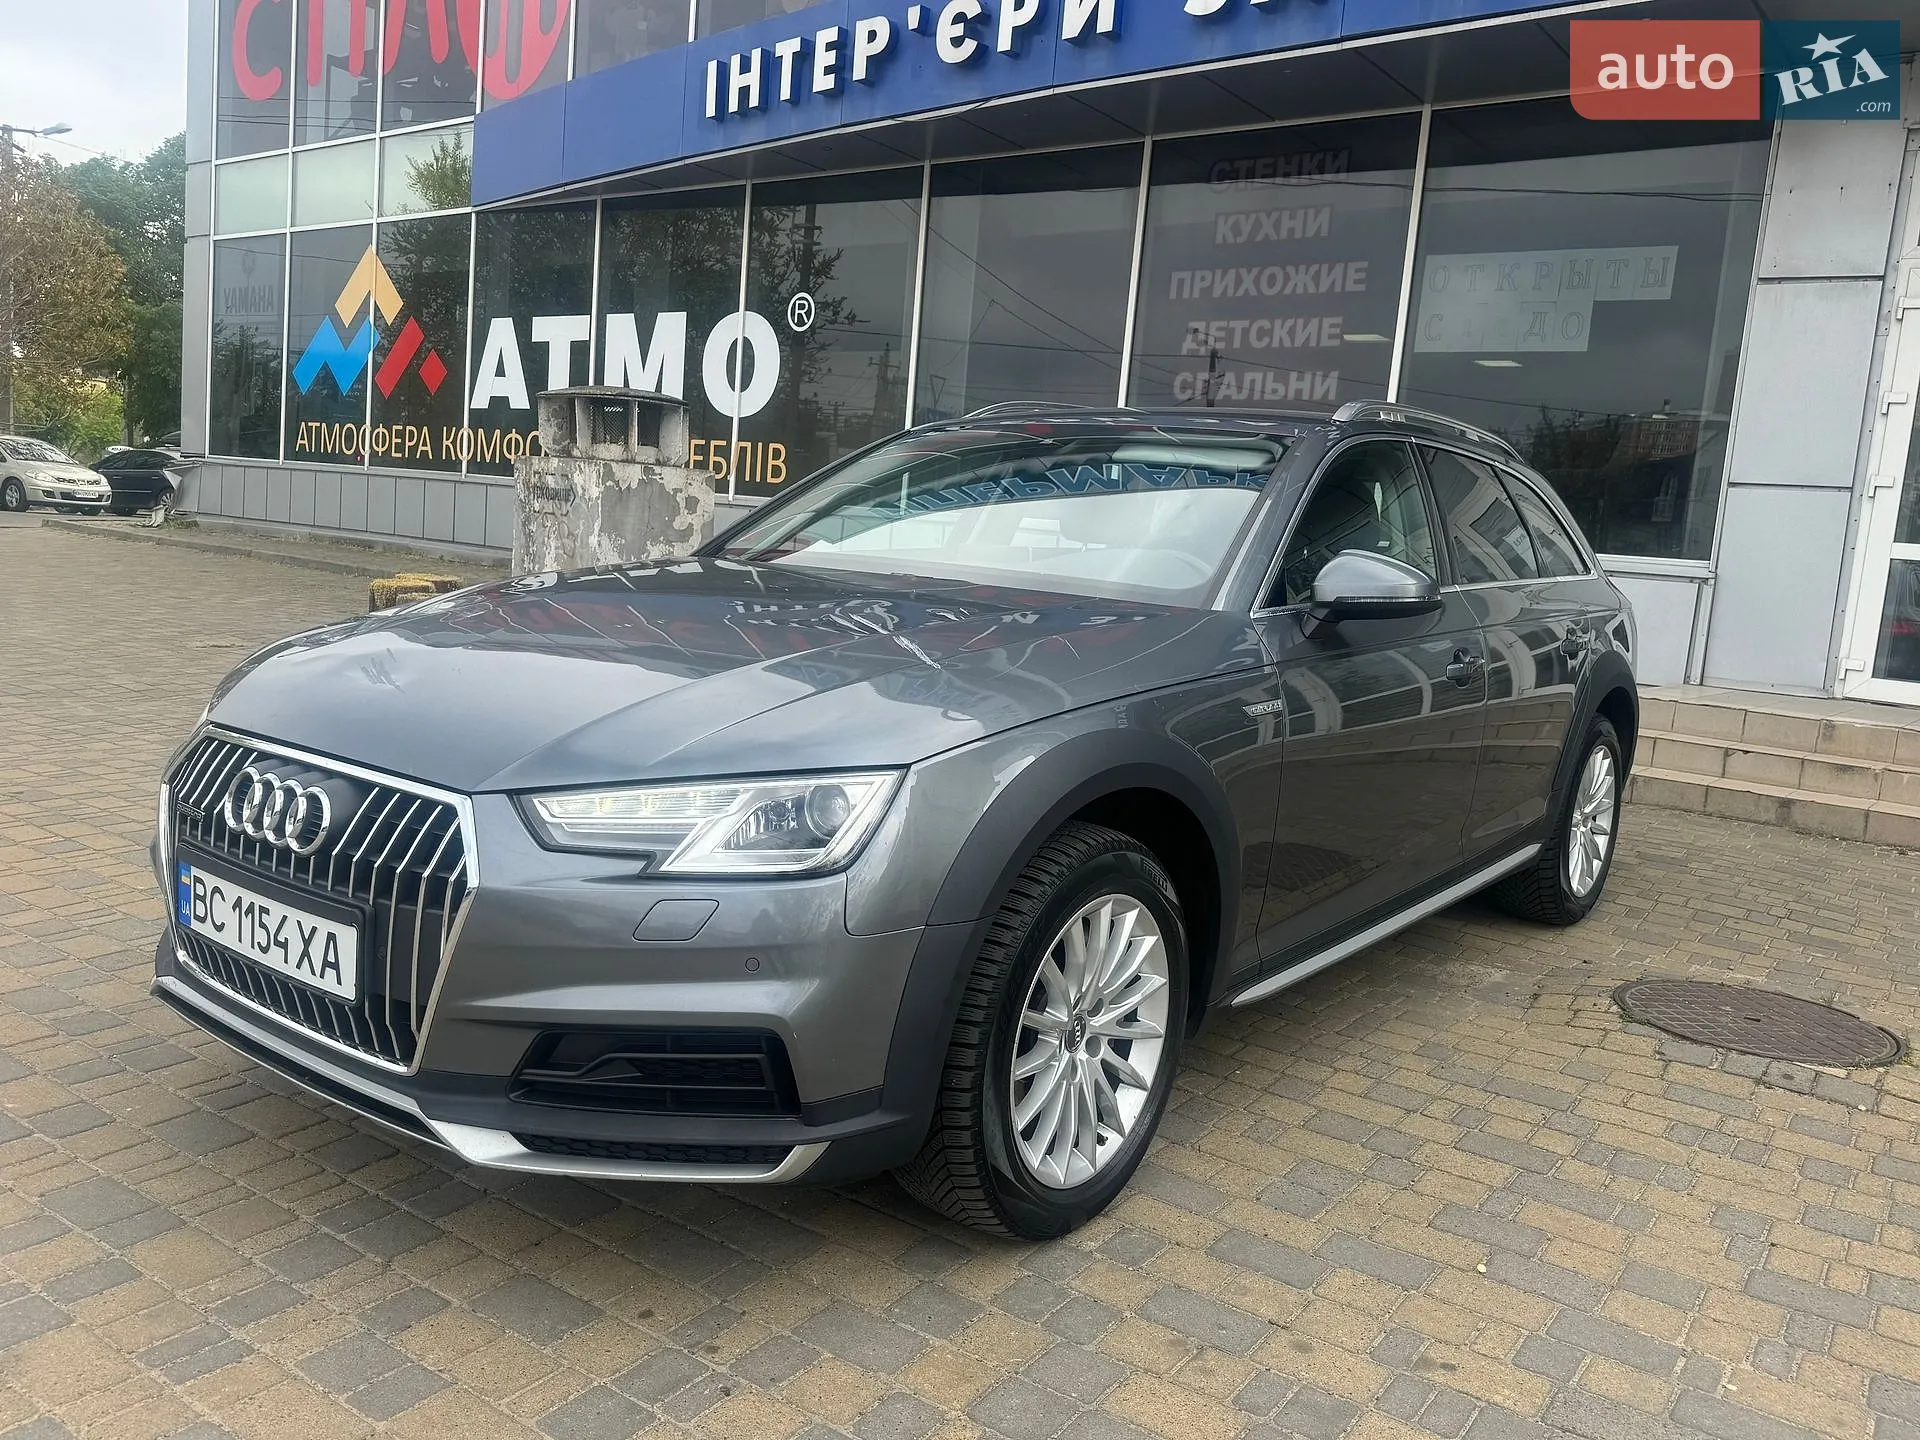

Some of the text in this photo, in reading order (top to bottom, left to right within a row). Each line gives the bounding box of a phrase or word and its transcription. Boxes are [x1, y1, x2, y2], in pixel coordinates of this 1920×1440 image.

[1209, 149, 1352, 193] СТЕНКИ
[1214, 205, 1332, 245] КУХНИ
[1168, 261, 1369, 300] ПРИХОЖИЕ
[1428, 256, 1671, 293] ОТКРЫТЫ
[1181, 316, 1343, 355] ДЕТСКИЕ
[470, 310, 781, 418] АТМО
[295, 421, 788, 484] АТМОСФЕРА КОМФО ЕБЛІВ
[181, 899, 190, 917] UA
[192, 874, 343, 986] BC 1154 XA
